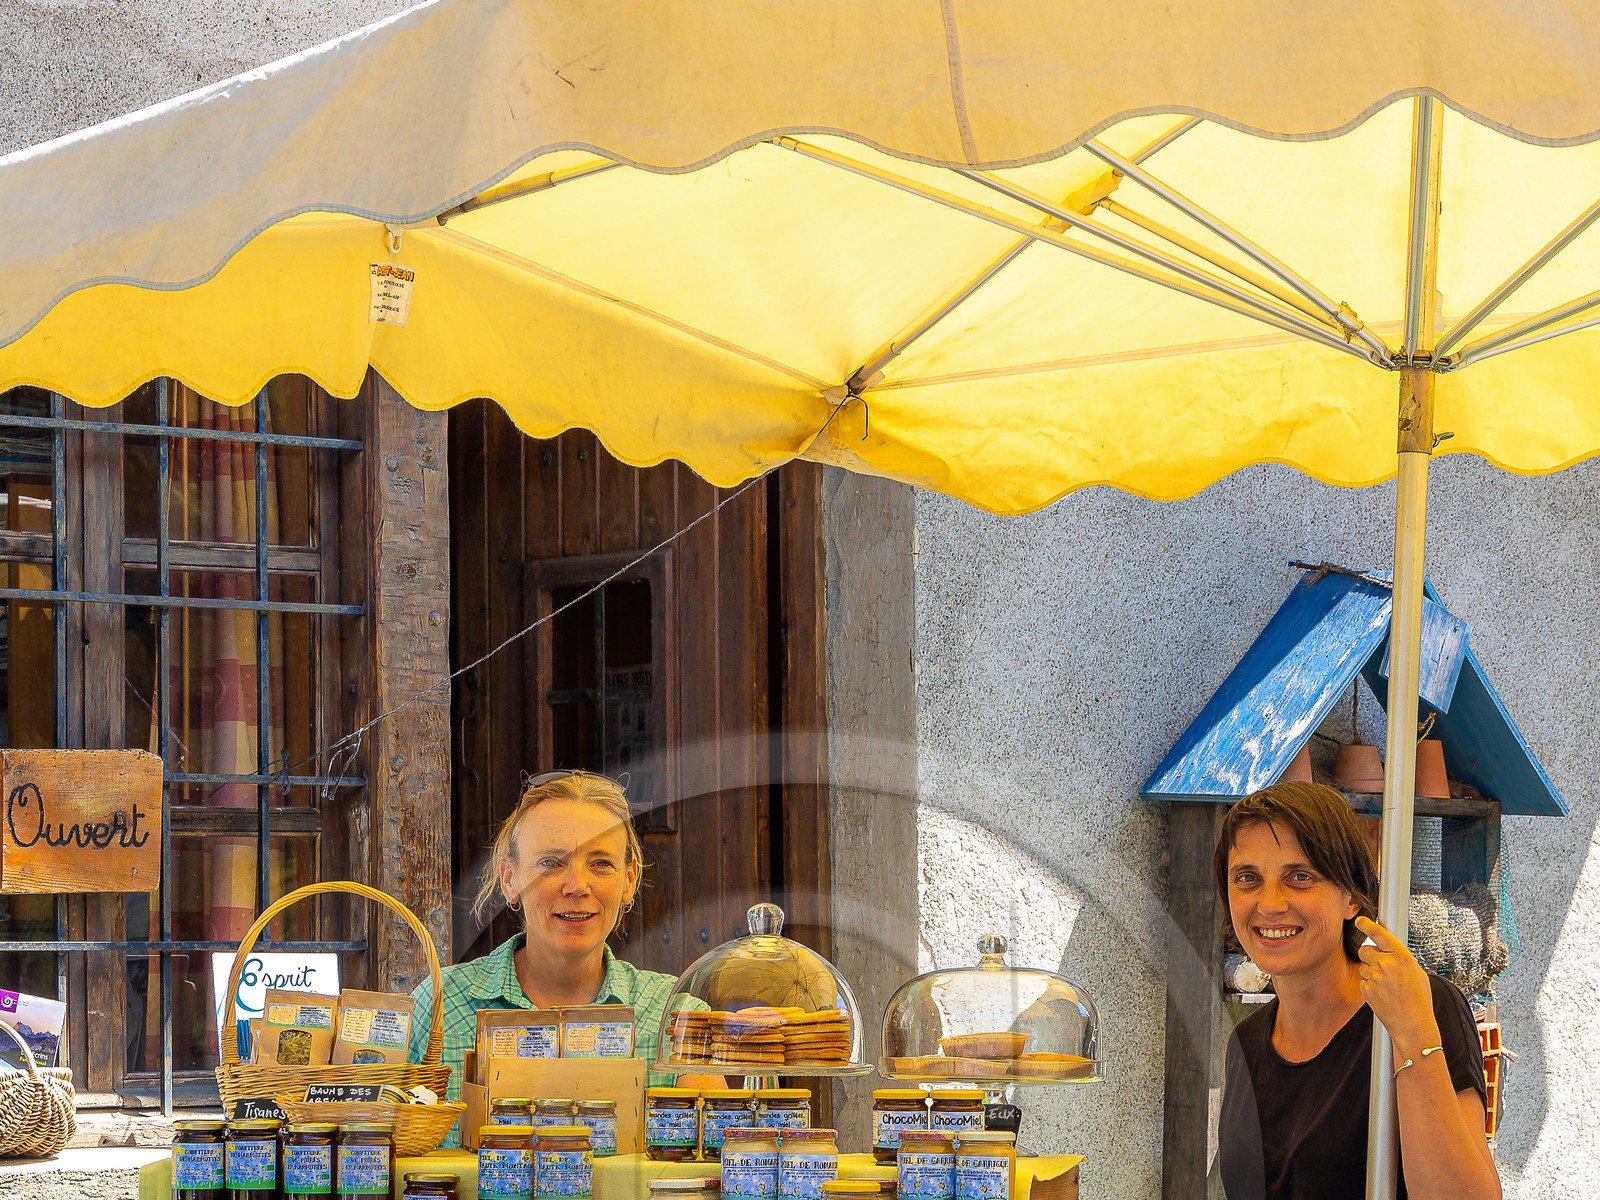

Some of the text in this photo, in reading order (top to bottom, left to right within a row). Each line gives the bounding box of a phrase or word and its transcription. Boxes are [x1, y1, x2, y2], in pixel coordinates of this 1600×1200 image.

[7, 782, 150, 848] Ouvert
[235, 957, 317, 1012] Esprit
[310, 1086, 372, 1096] BAUME DES
[243, 1101, 287, 1120] Tisanes
[758, 1111, 781, 1119] mandes
[934, 1114, 982, 1126] ChocoMiel
